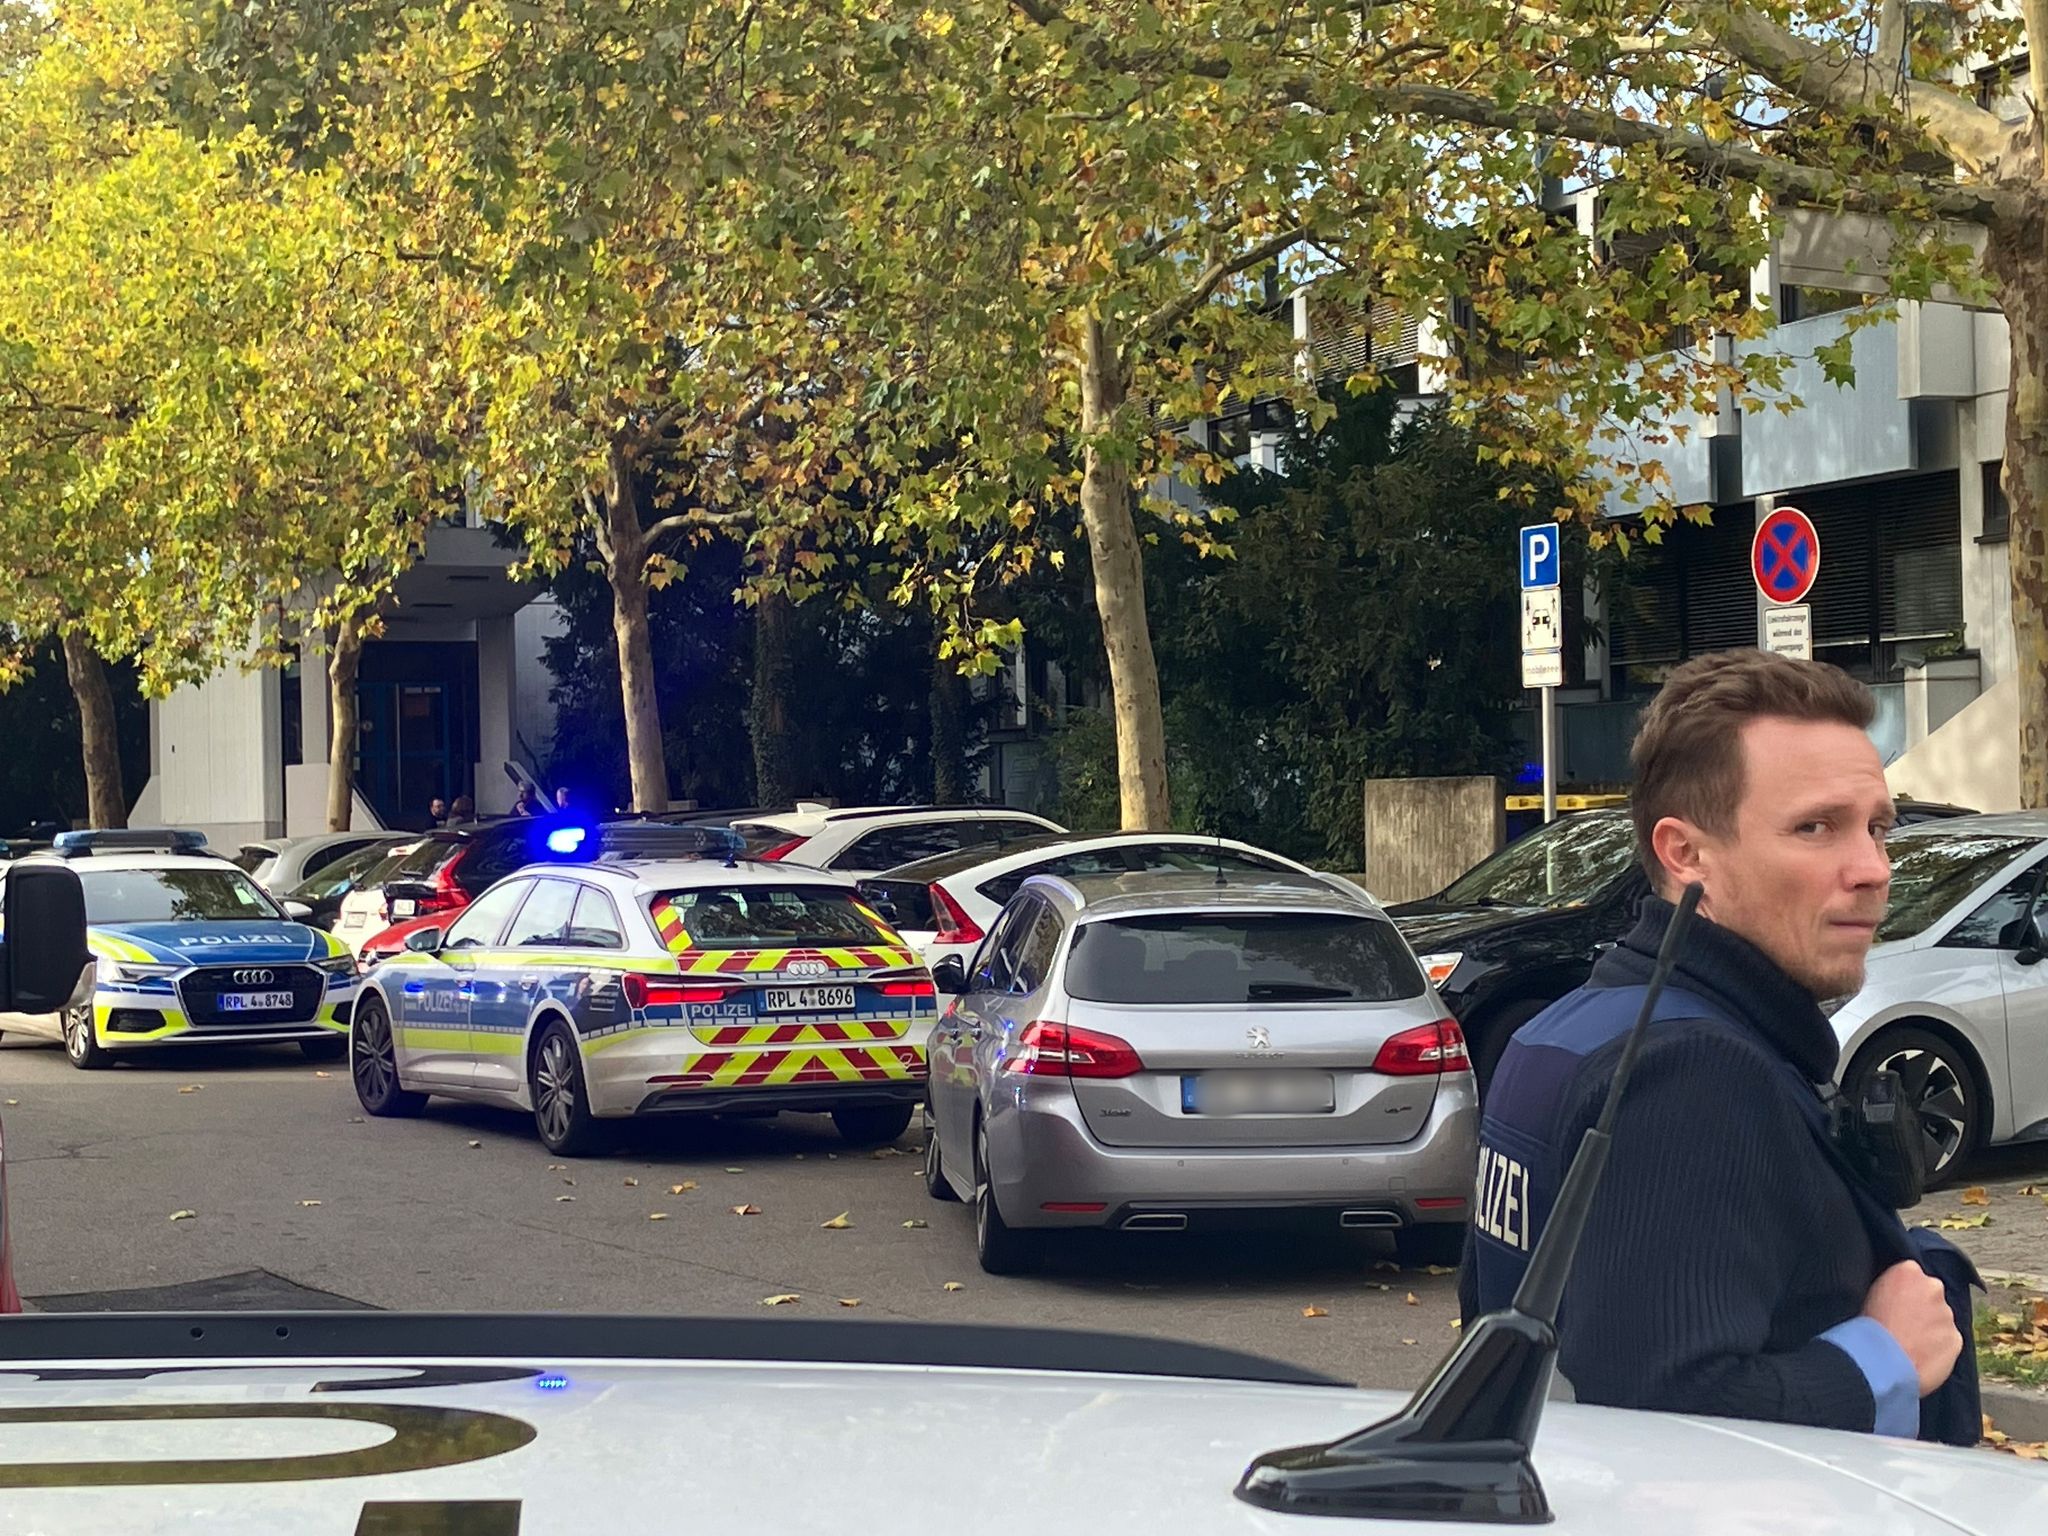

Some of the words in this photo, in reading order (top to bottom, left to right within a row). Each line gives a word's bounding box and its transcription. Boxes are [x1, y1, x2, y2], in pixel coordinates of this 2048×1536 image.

[1529, 534, 1549, 580] P
[180, 935, 292, 946] POLIZEI
[225, 995, 247, 1008] RPL
[265, 994, 292, 1007] 8748
[767, 991, 796, 1008] RPL
[800, 991, 808, 1007] 4
[818, 989, 853, 1006] 8696
[691, 1004, 751, 1018] POLIZEI
[1475, 1146, 1529, 1251] LIZEI
